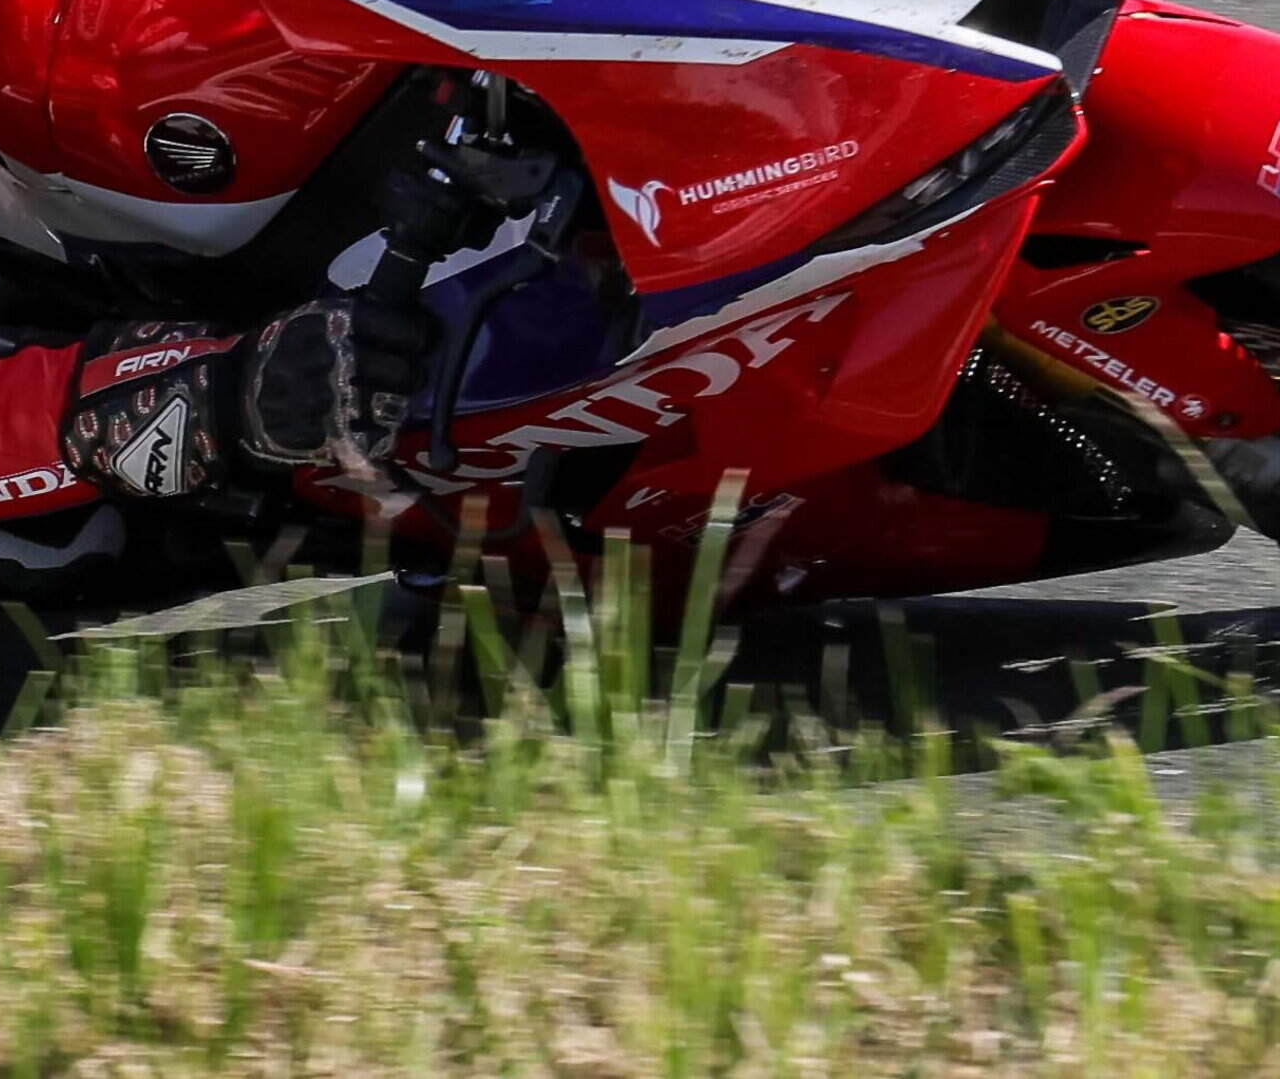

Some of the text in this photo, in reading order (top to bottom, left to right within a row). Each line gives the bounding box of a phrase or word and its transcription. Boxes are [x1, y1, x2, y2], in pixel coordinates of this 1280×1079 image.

[678, 139, 860, 206] HUMMINGBIRD
[114, 345, 191, 377] ARN
[1030, 320, 1175, 409] METZELER
[143, 426, 173, 492] ARN
